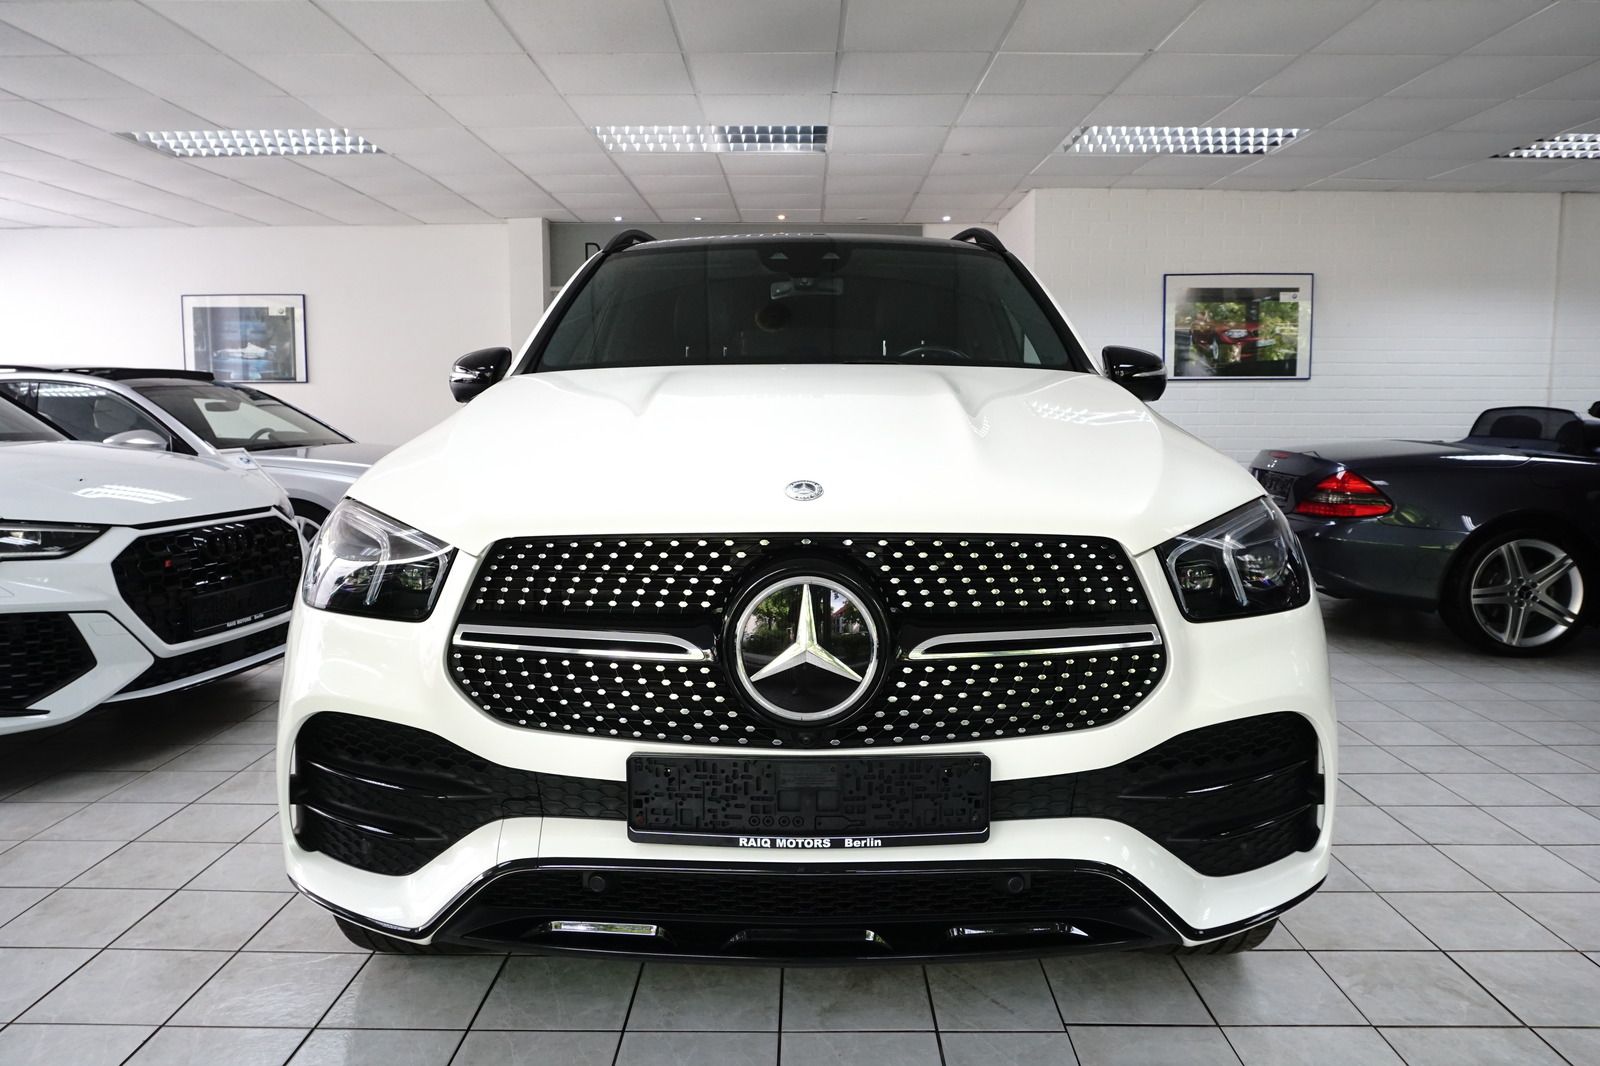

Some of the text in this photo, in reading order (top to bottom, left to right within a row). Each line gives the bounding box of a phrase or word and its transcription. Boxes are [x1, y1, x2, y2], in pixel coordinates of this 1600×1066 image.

[739, 837, 882, 848] RAIQ MOTORS Berlin
